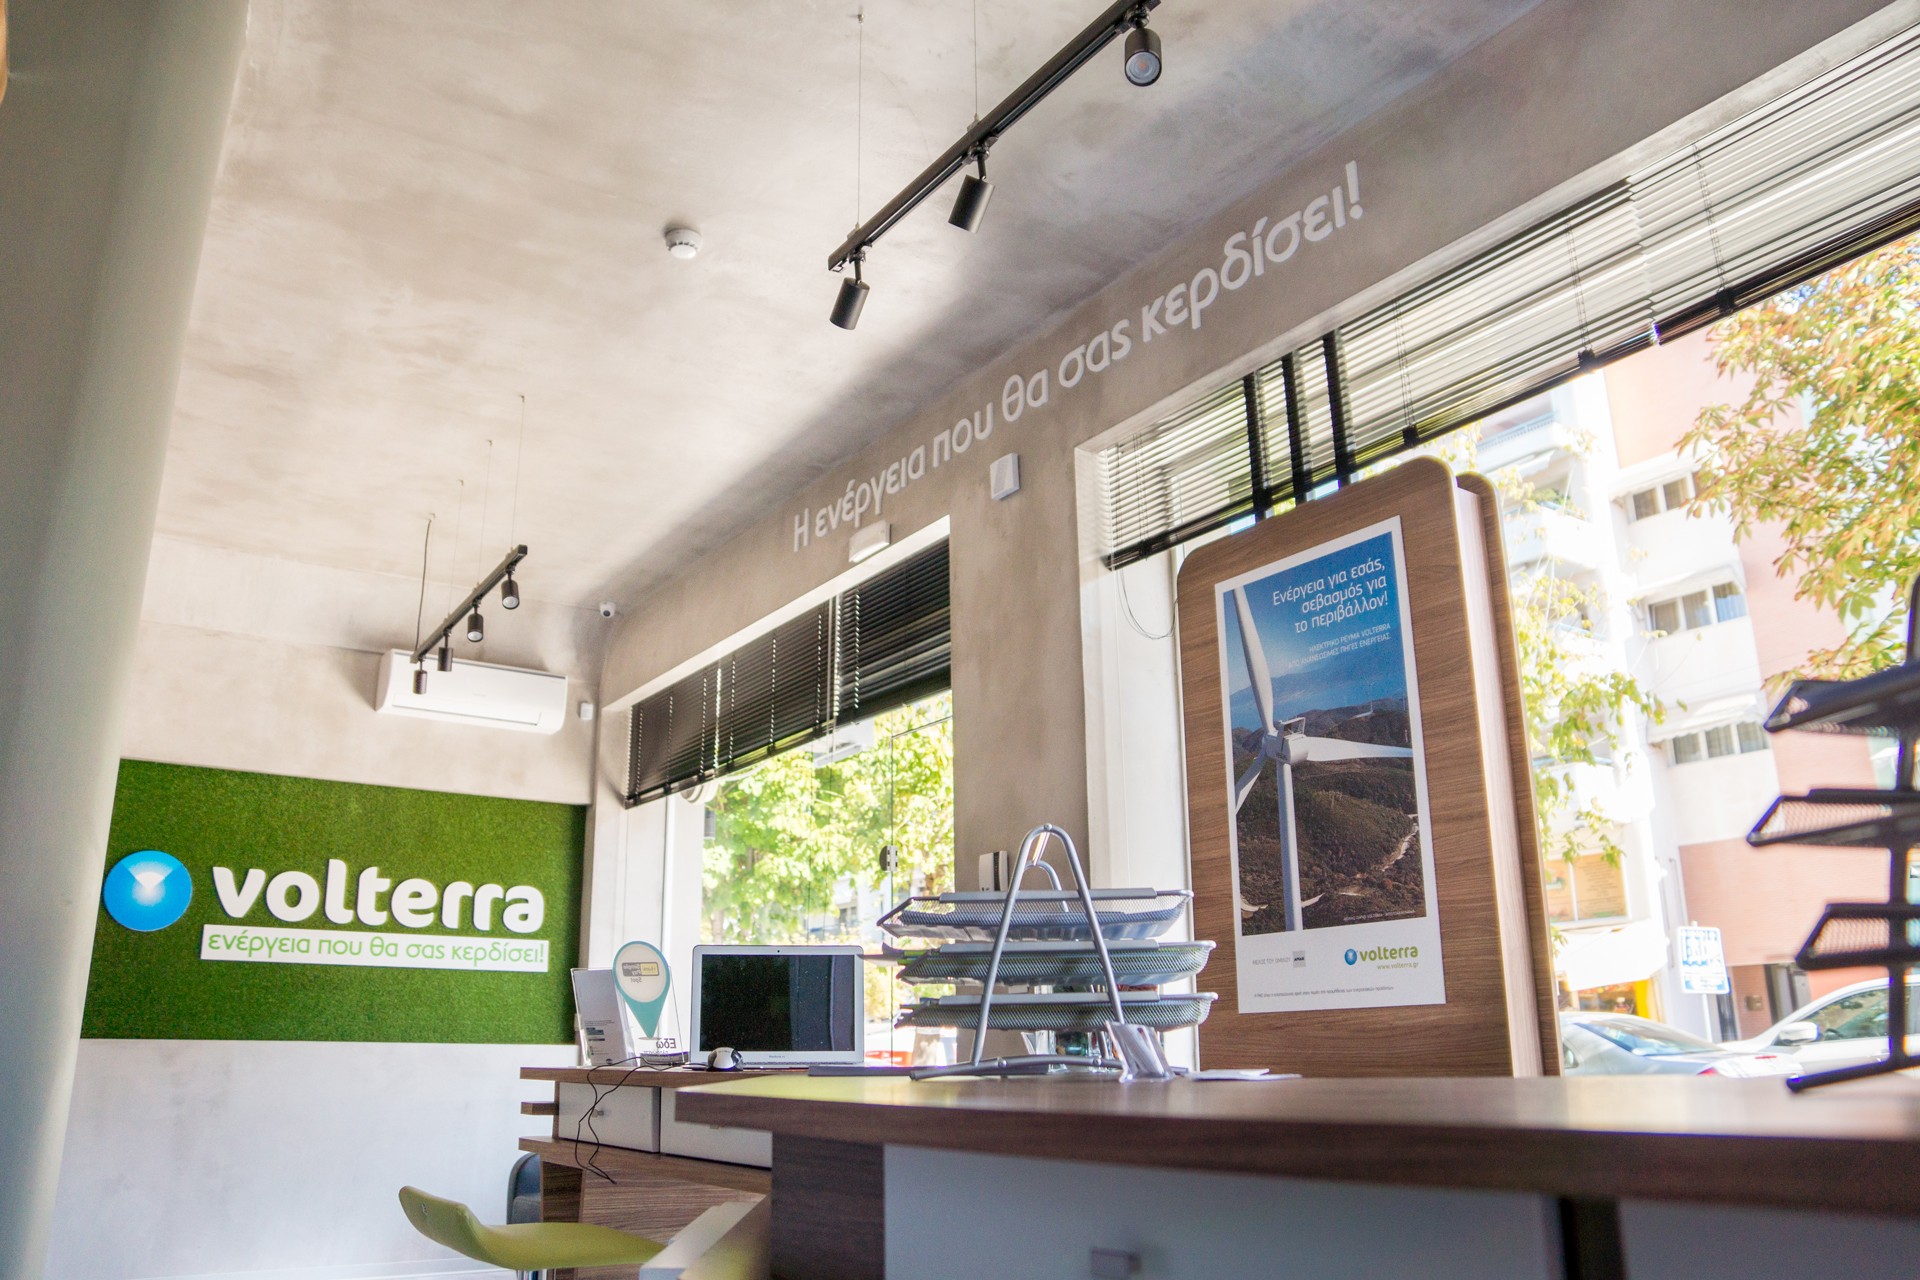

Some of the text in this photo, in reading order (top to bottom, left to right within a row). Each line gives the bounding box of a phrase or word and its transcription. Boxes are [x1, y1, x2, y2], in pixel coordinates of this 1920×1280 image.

[794, 160, 1363, 552] Η ενέργεια που θα σας κερδίσει!
[1273, 557, 1386, 606] Ενέργεια για εσάς,
[1302, 575, 1388, 614] σεβασμός για
[1294, 590, 1389, 634] το περιβάλλον!
[1340, 632, 1360, 644] ΡΕΥΜΑ
[1361, 622, 1391, 637] VOLTERRA
[212, 858, 544, 934] volterra
[207, 929, 544, 967] ενέργεια που θα σας κερδίσει!
[1359, 946, 1418, 962] volterra
[1377, 962, 1419, 970] www.volterra.gr
